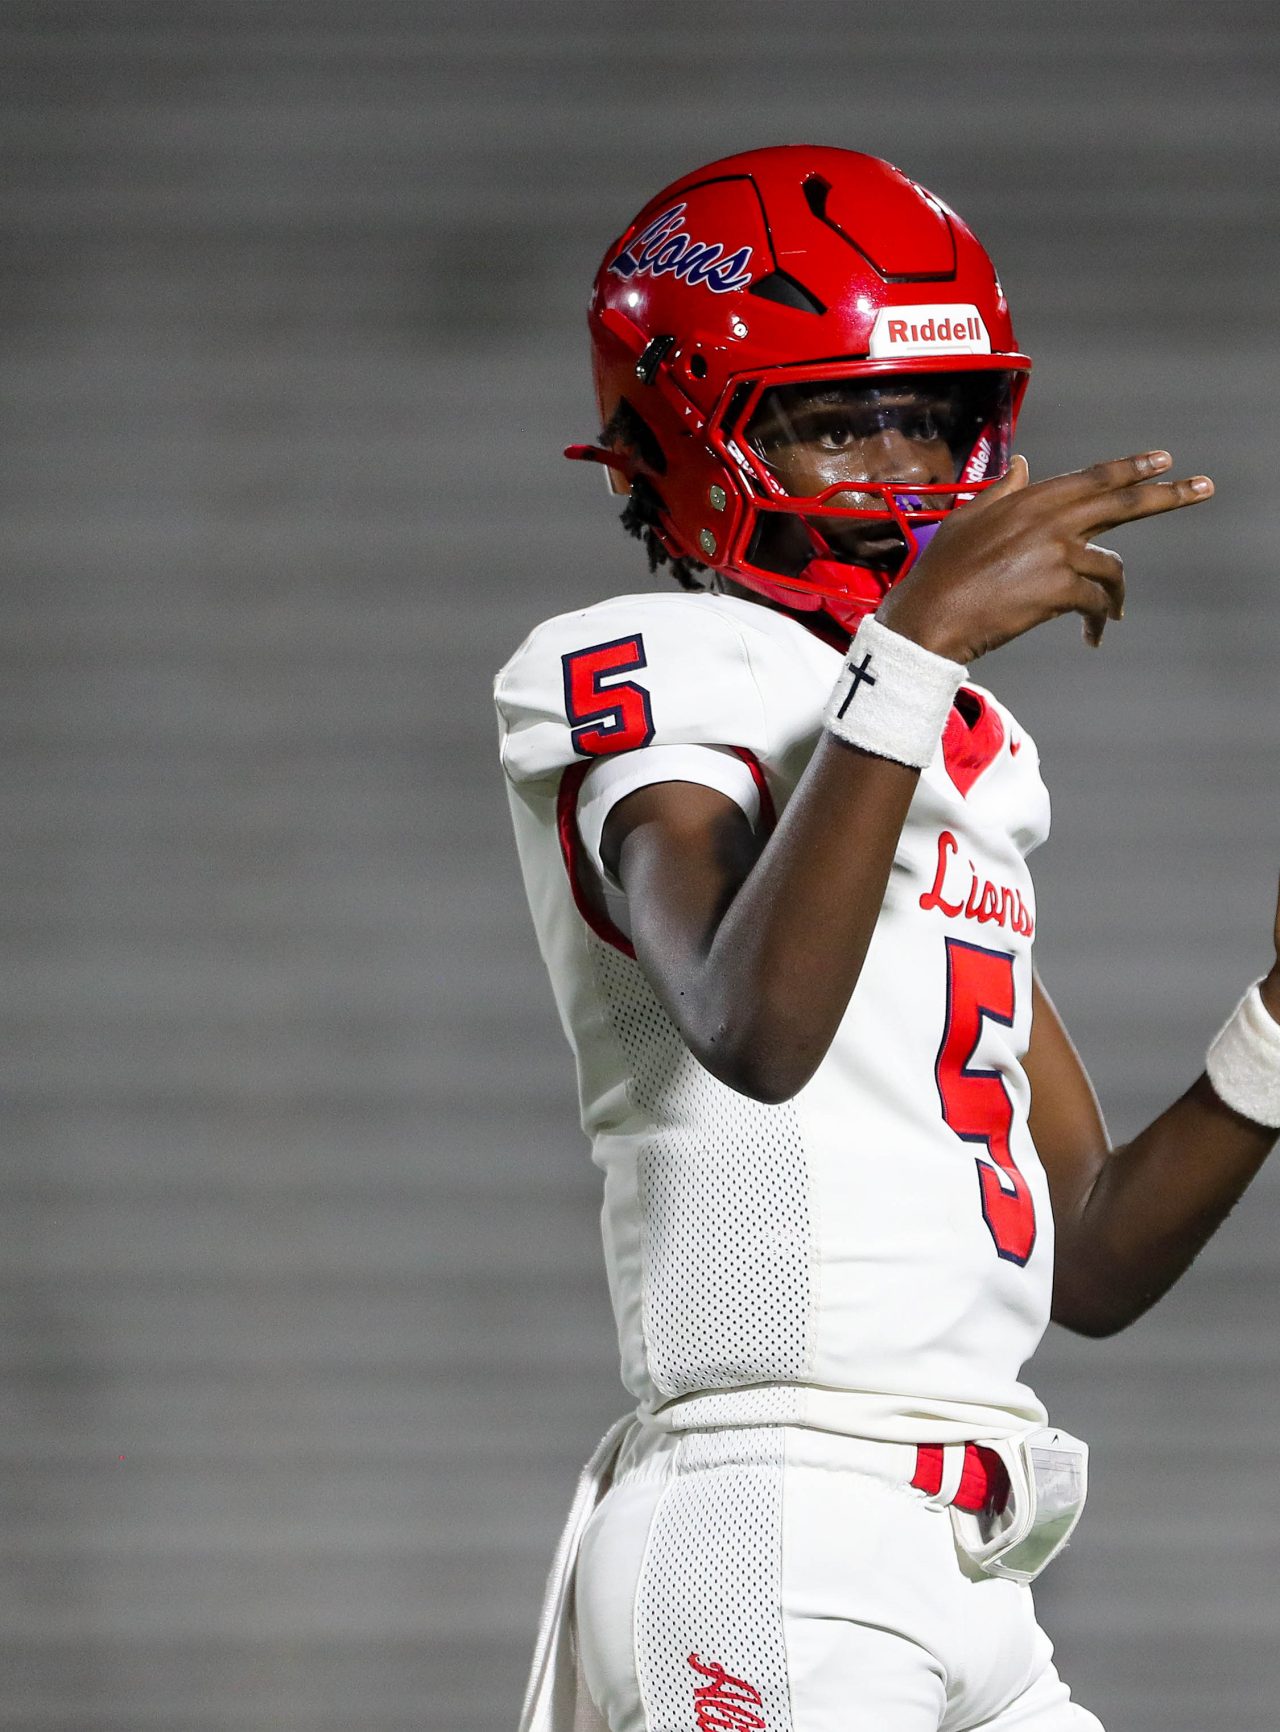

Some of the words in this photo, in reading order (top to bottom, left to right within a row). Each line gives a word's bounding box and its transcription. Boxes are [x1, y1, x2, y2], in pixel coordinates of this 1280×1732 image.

[607, 202, 753, 293] Lions
[887, 317, 982, 343] Riddell
[561, 632, 656, 758] 5
[918, 830, 1034, 938] Lions
[934, 936, 1038, 1268] 5
